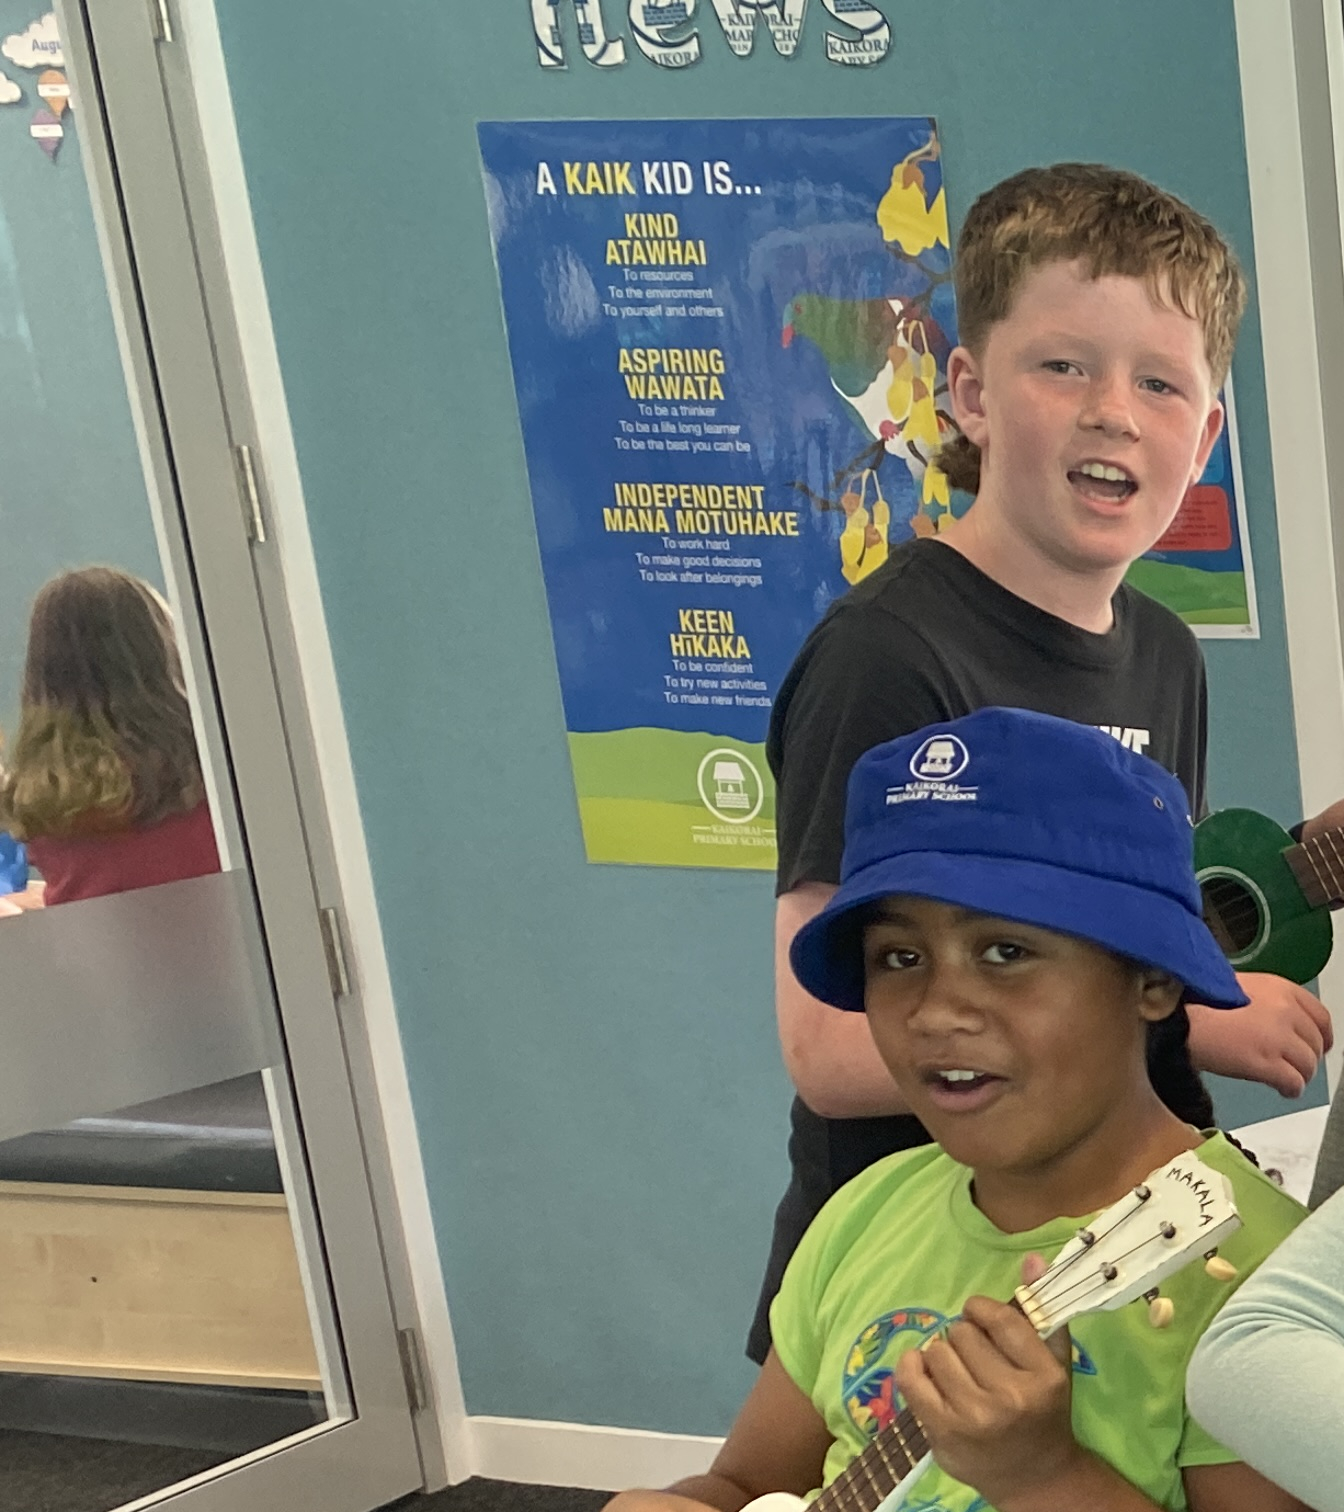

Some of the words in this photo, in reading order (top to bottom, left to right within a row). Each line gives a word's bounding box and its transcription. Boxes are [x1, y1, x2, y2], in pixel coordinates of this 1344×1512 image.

[537, 161, 557, 195] A
[563, 161, 636, 195] KAIK
[642, 161, 693, 195] KID
[703, 161, 762, 195] IS...
[624, 213, 679, 238] KIND
[606, 240, 707, 266] ATAWHAI
[623, 268, 637, 281] To
[640, 271, 694, 281] resources
[608, 285, 623, 299] To
[625, 287, 643, 299] the
[645, 287, 713, 299] environment
[602, 303, 617, 316] To
[619, 304, 662, 319] yourself
[665, 305, 686, 317] and
[688, 305, 724, 317] others
[619, 348, 725, 374] ASPIRING
[624, 374, 725, 400] WAWATA
[638, 403, 653, 416] To
[654, 404, 669, 416] be
[671, 406, 679, 417] a
[680, 405, 716, 417] thinker
[619, 420, 634, 433] To
[635, 421, 649, 433] be
[652, 423, 659, 433] a
[660, 421, 677, 434] life
[678, 422, 702, 436] long
[703, 422, 741, 434] learner
[614, 437, 629, 450] To
[631, 438, 645, 450] be
[647, 439, 664, 450] the
[666, 440, 689, 451] best
[690, 441, 711, 454] you
[713, 441, 733, 452] can
[735, 440, 751, 452] be
[614, 483, 765, 509] INDEPENDENT
[603, 508, 670, 533] MANA
[675, 510, 800, 537] MOTUHAKE
[661, 537, 676, 549] To
[678, 539, 704, 550] work
[705, 538, 730, 551] hard
[635, 552, 650, 565] To
[652, 554, 680, 566] make
[682, 555, 710, 569] good
[711, 555, 762, 567] decisions
[639, 569, 654, 581] To
[655, 569, 678, 582] look
[680, 570, 703, 583] after
[704, 571, 763, 588] belongings
[679, 609, 735, 634] KEEN
[672, 659, 687, 671] To
[688, 660, 703, 672] be
[704, 661, 754, 674] confident
[664, 675, 679, 687] To
[680, 676, 694, 690] try
[696, 679, 719, 689] new
[721, 678, 768, 691] activities
[664, 691, 679, 703] To
[680, 693, 709, 705] make
[711, 696, 733, 706] new
[735, 694, 773, 707] friends
[1166, 1167, 1215, 1228] MAKALA
